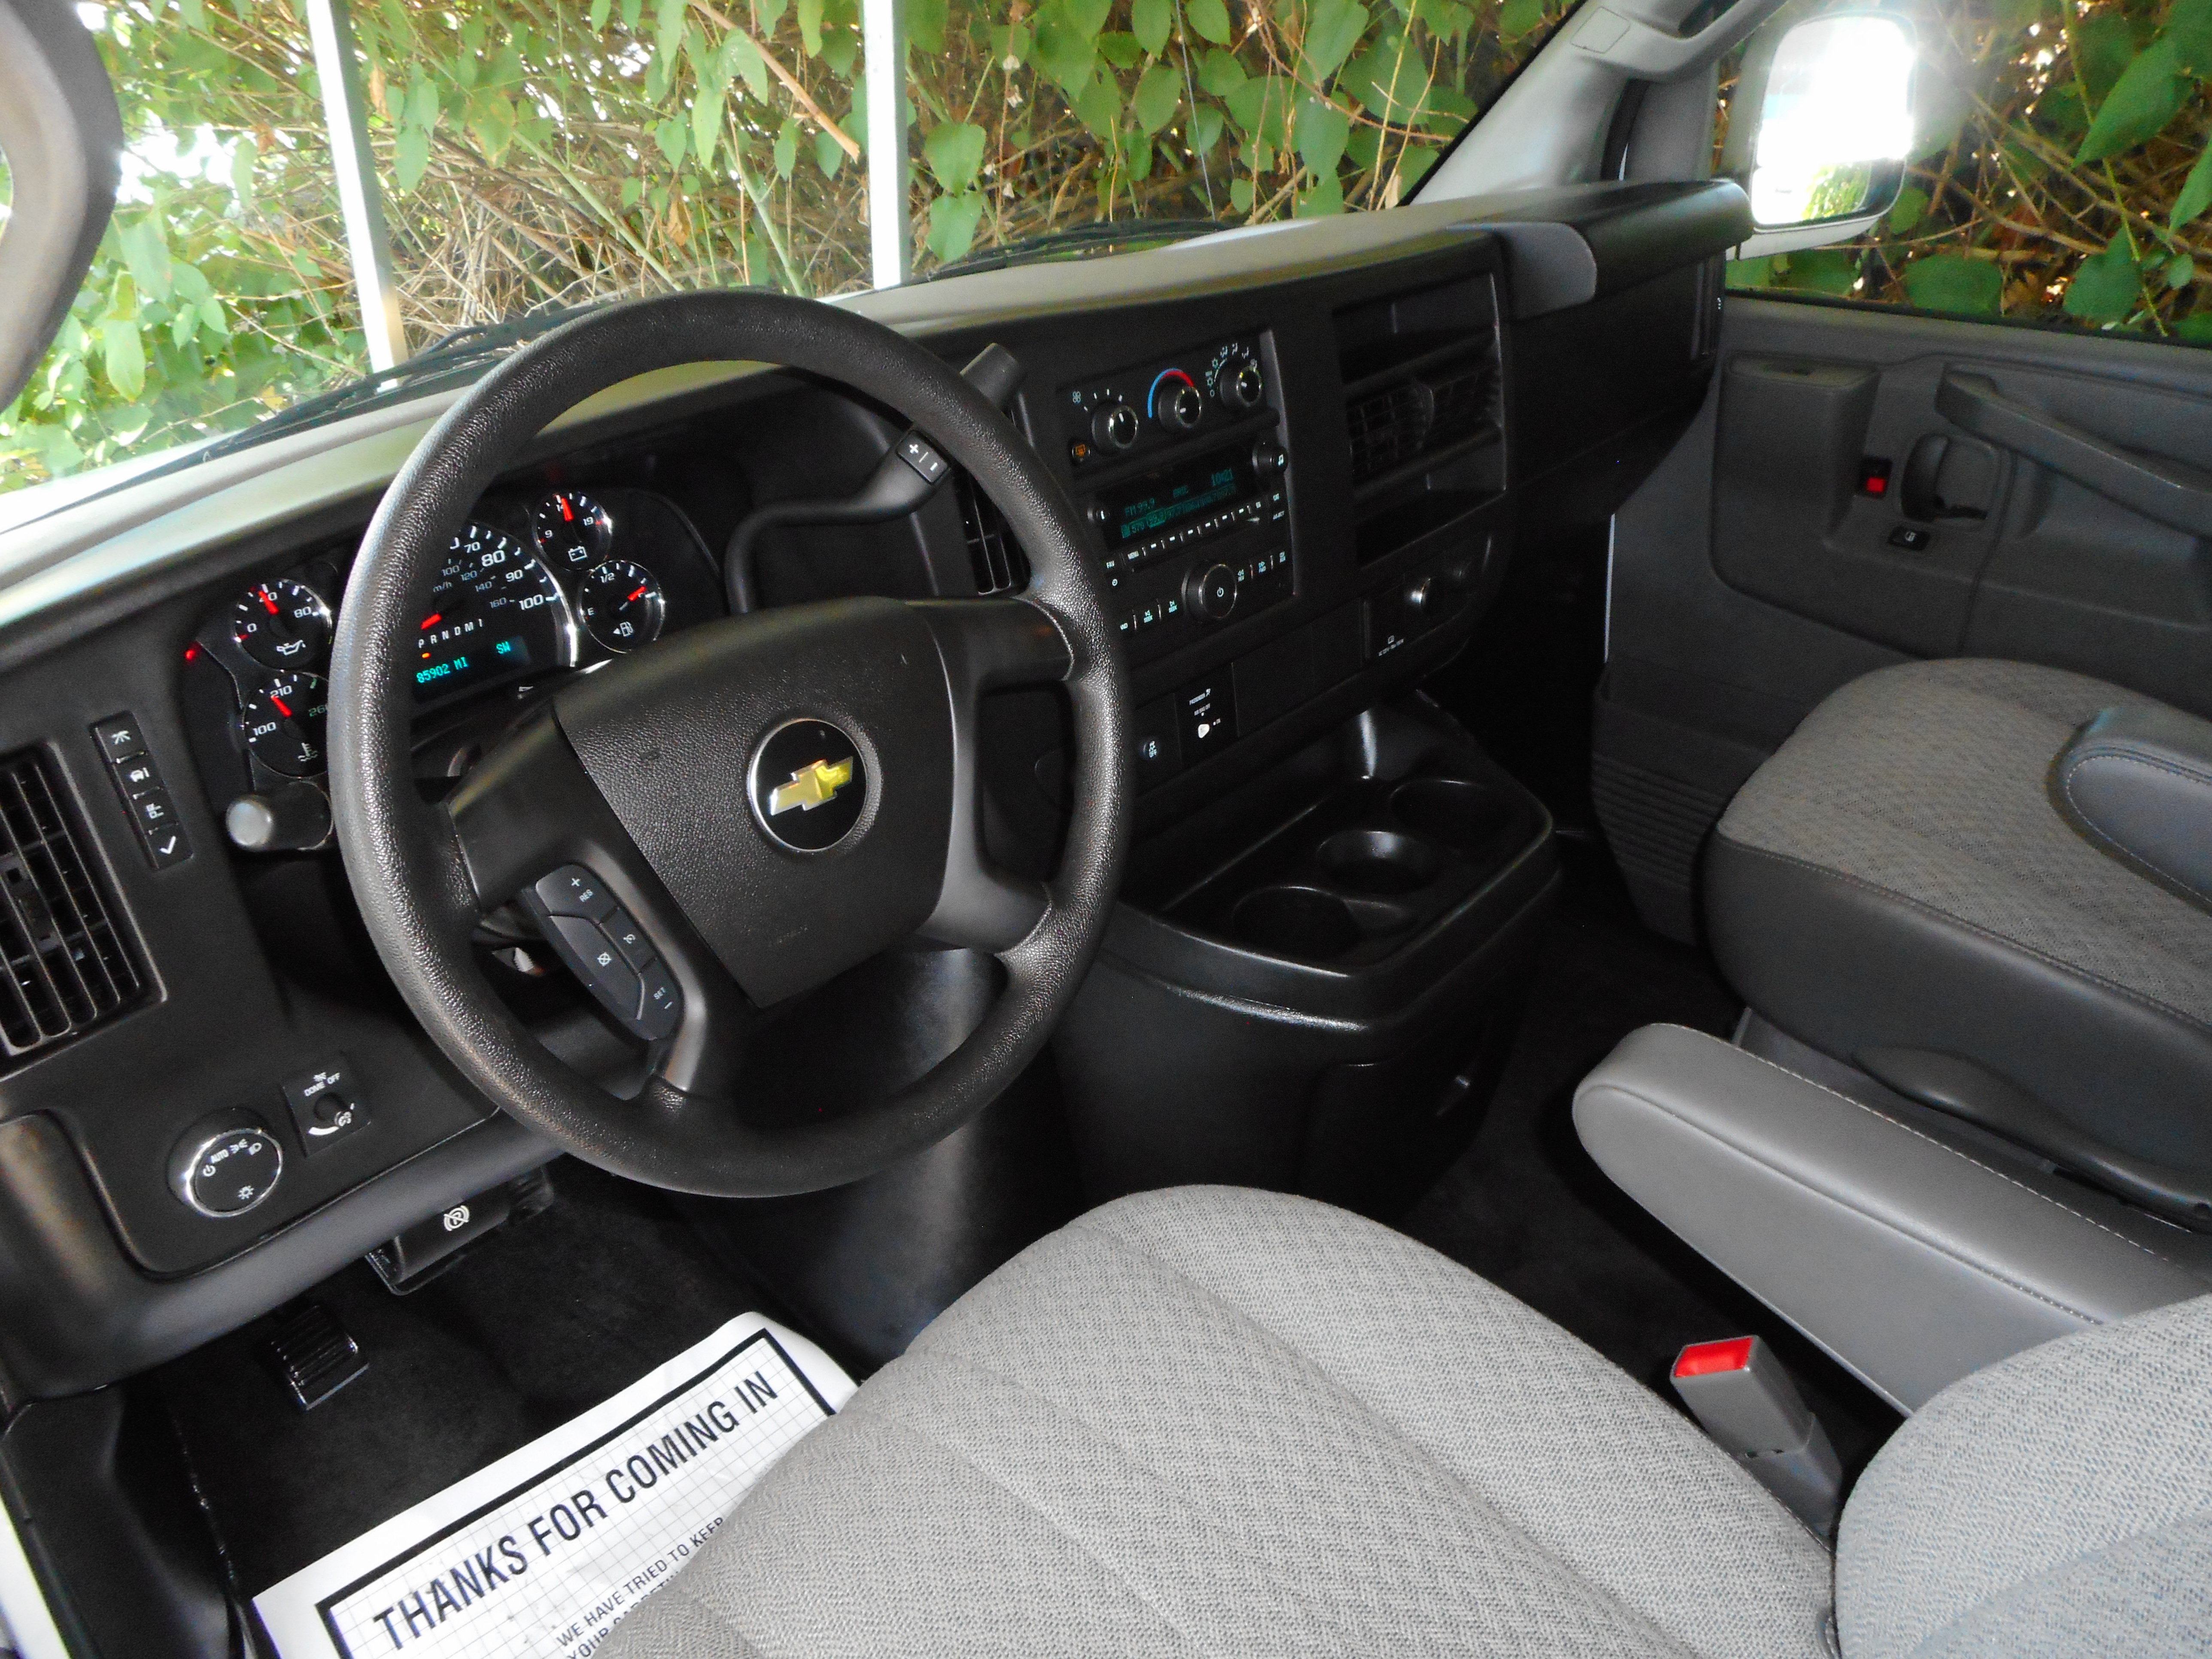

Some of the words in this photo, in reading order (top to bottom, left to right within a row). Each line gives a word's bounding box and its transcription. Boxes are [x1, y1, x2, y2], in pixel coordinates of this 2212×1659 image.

[583, 517, 594, 526] 19
[464, 541, 480, 553] 70
[481, 550, 505, 567] 80
[1106, 560, 1115, 568] FAV
[442, 565, 459, 576] 100
[461, 570, 477, 581] 120
[505, 569, 523, 582] 90
[601, 572, 614, 583] 1/2
[433, 581, 452, 593] m/h
[475, 581, 492, 592] 140
[489, 597, 507, 608] 160
[519, 594, 544, 610] 100
[294, 606, 311, 618] 80
[587, 608, 595, 616] E
[247, 623, 257, 632] 0
[418, 639, 424, 648] P
[431, 635, 437, 644] R
[442, 630, 449, 640] N
[454, 626, 461, 635] D
[465, 622, 474, 632] M
[416, 664, 450, 683] 85902
[454, 657, 468, 670] MI
[270, 685, 292, 698] 210
[309, 705, 327, 717] 26
[253, 722, 276, 736] 100
[579, 889, 593, 902] RES
[653, 987, 665, 1000] SET
[327, 1073, 340, 1084] OFF
[304, 1082, 325, 1096] DOME
[211, 1149, 229, 1164] AUTO
[373, 1534, 529, 1650] THANKS
[528, 1489, 608, 1556] FOR
[605, 1401, 740, 1503] COMING
[735, 1371, 778, 1414] IN
[556, 1623, 583, 1647] WE
[584, 1591, 625, 1626] HAVE
[623, 1559, 667, 1595] TRIED
[667, 1544, 690, 1562] TO
